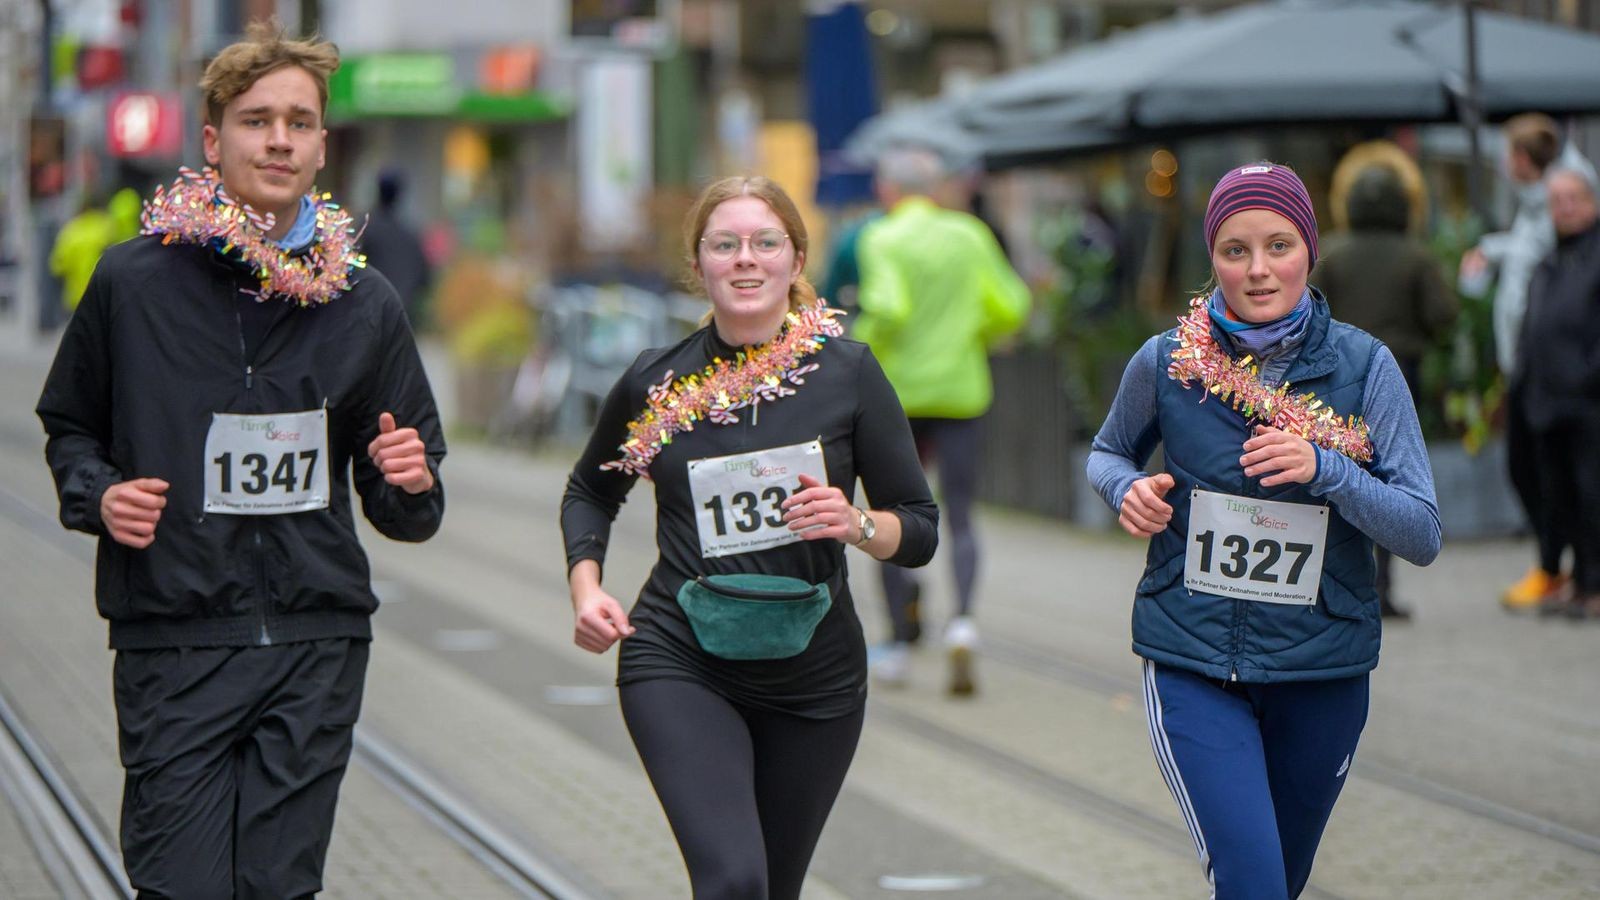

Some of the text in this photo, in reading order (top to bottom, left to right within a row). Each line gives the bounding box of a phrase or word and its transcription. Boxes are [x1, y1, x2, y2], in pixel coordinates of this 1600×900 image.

[240, 418, 269, 431] Time
[213, 448, 319, 495] 1347
[724, 460, 753, 473] Time
[1225, 498, 1256, 515] Time
[1195, 529, 1314, 585] 1327
[1199, 580, 1219, 589] Partner
[1228, 586, 1260, 596] Zeitnahme
[1261, 590, 1273, 598] und
[1273, 592, 1306, 600] Moderation
